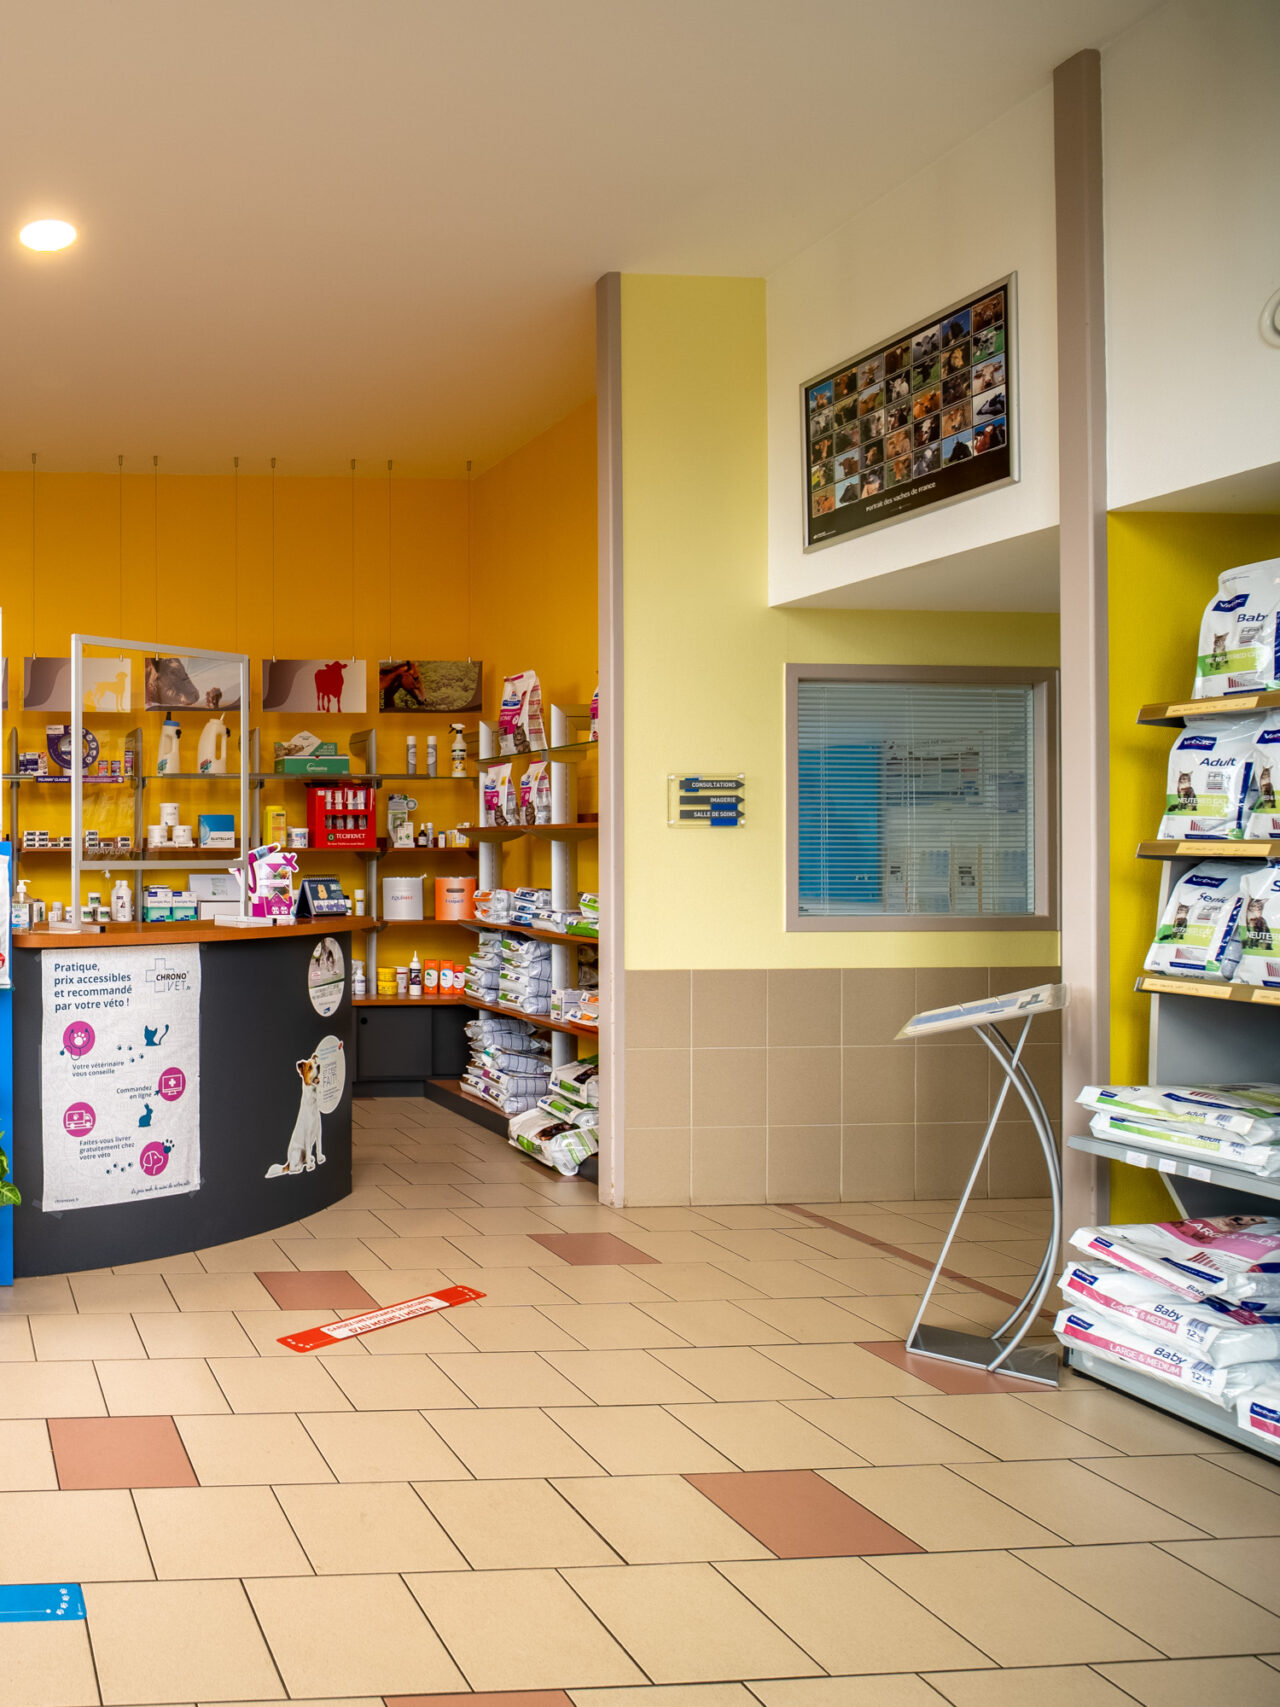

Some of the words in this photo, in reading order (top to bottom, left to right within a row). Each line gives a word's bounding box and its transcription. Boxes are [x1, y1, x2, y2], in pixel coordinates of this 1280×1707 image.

[1237, 613, 1268, 622] Bab
[1200, 758, 1236, 766] Adult
[54, 962, 100, 973] Pratique,
[54, 977, 73, 987] prix
[77, 973, 131, 984] accessibles
[156, 972, 186, 981] CHRONO
[55, 989, 64, 998] et
[68, 985, 132, 997] recommandé
[55, 1003, 72, 1013] par
[75, 1001, 101, 1010] votre
[104, 999, 124, 1008] véto
[127, 998, 129, 1006] !
[91, 1061, 124, 1069] vétérinaire
[89, 1068, 115, 1076] conseille
[117, 1085, 152, 1094] Commandez
[1186, 1284, 1206, 1296] Bab
[1154, 1304, 1184, 1321] Baby
[1146, 1314, 1176, 1332] MEDIUM
[1109, 1343, 1137, 1358] LARGE
[1146, 1356, 1180, 1376] MEDIUM
[1154, 1347, 1188, 1365] Baby
